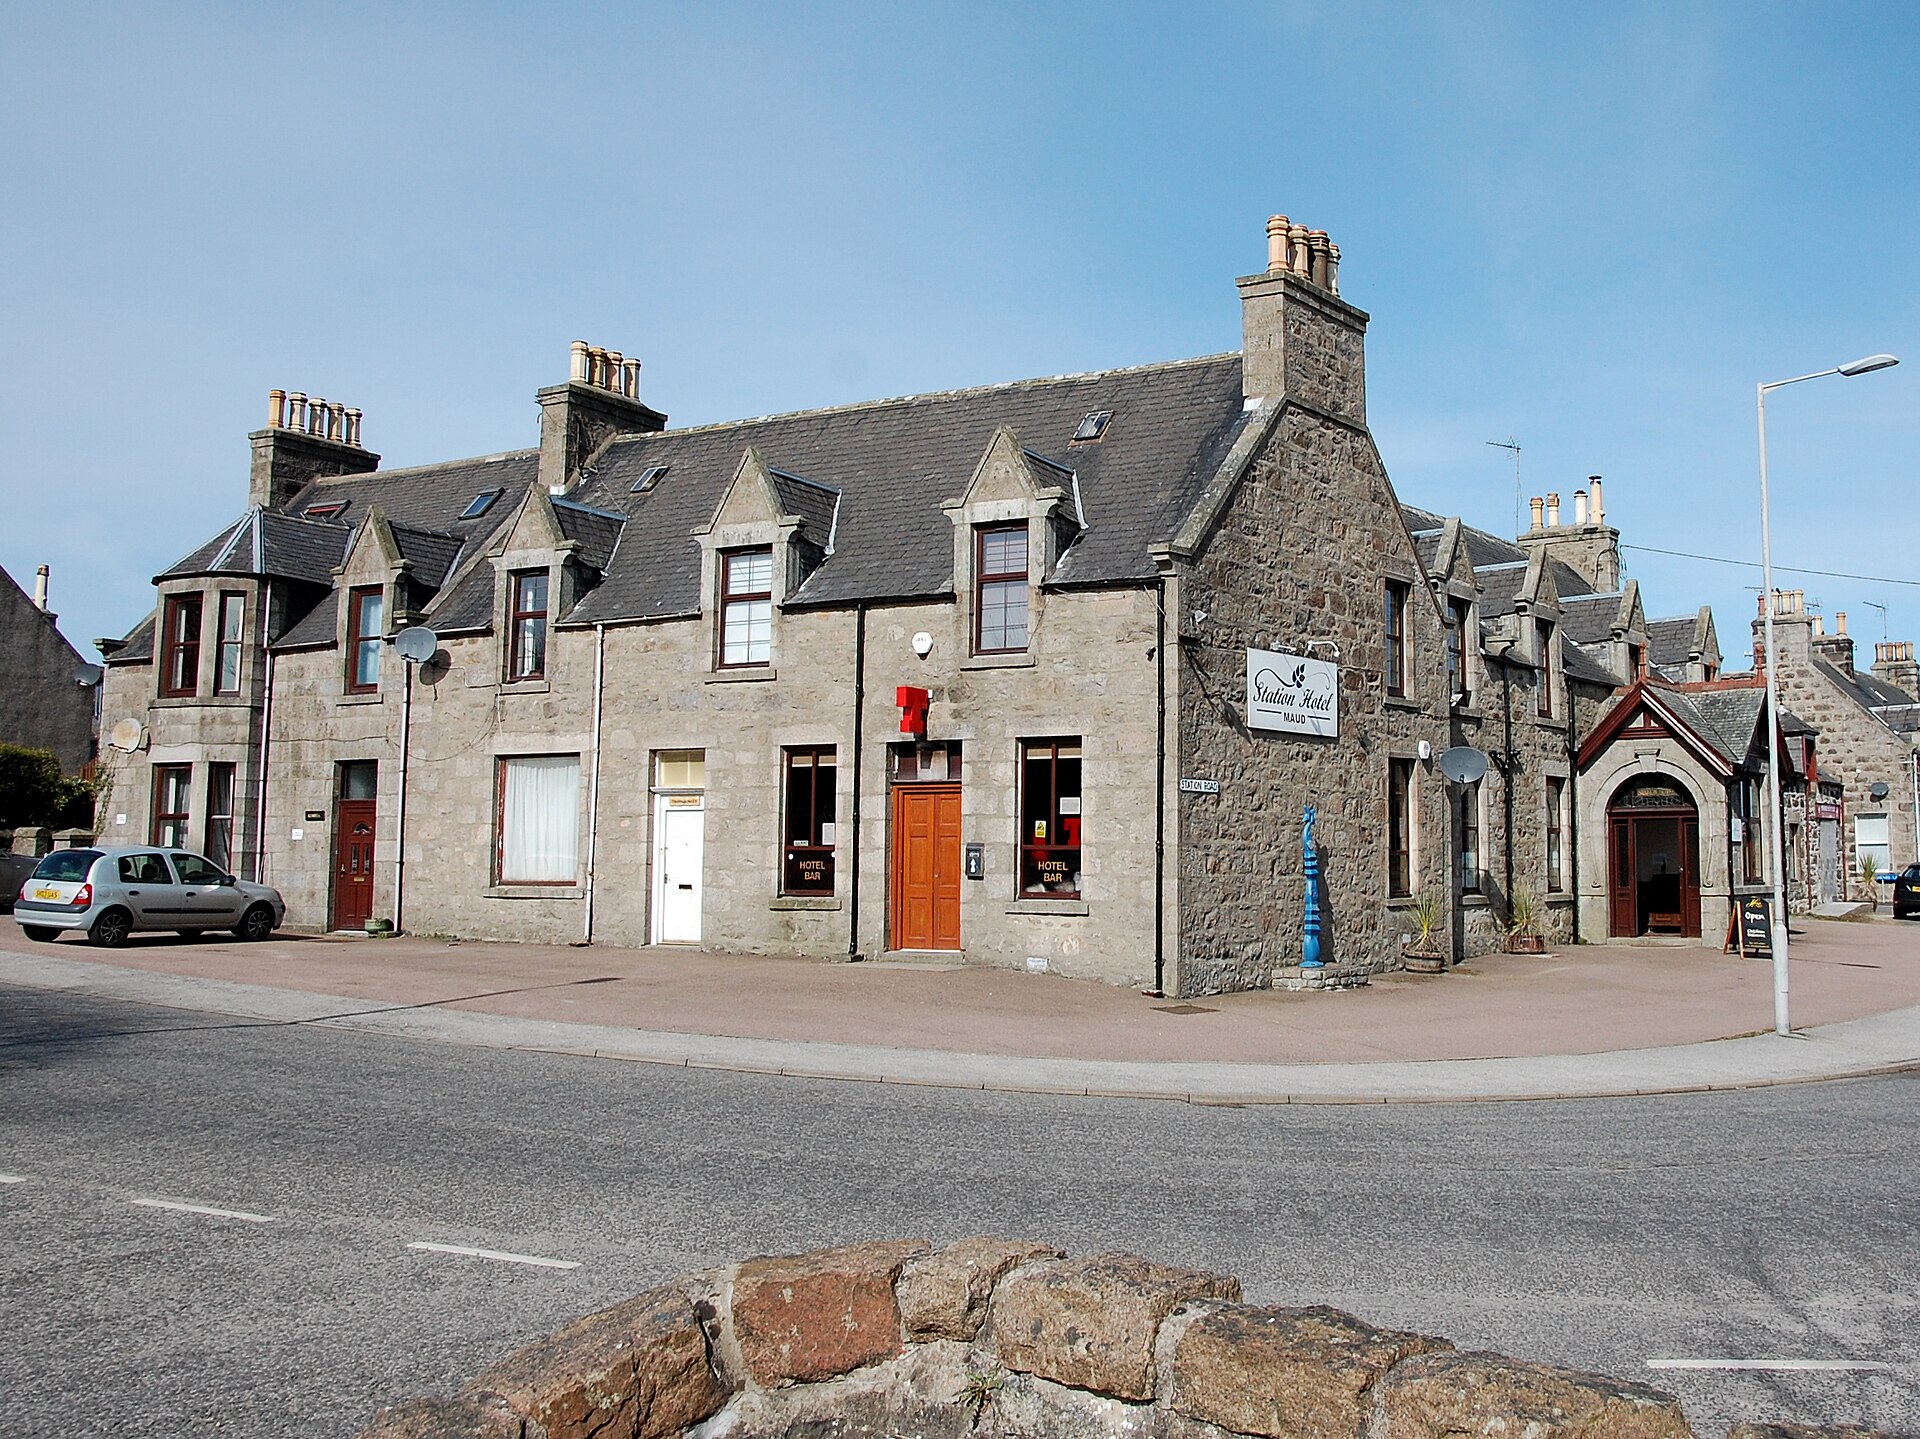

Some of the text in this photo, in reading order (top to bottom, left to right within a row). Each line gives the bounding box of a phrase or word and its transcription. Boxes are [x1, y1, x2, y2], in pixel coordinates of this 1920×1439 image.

[1253, 682, 1334, 711] Station Hotel
[1283, 712, 1306, 724] MAUD
[800, 861, 826, 870] HOTEL
[1038, 861, 1068, 871] HOTEL
[804, 871, 821, 880] BAR
[1043, 872, 1063, 882] BAR
[1745, 911, 1766, 923] Open
